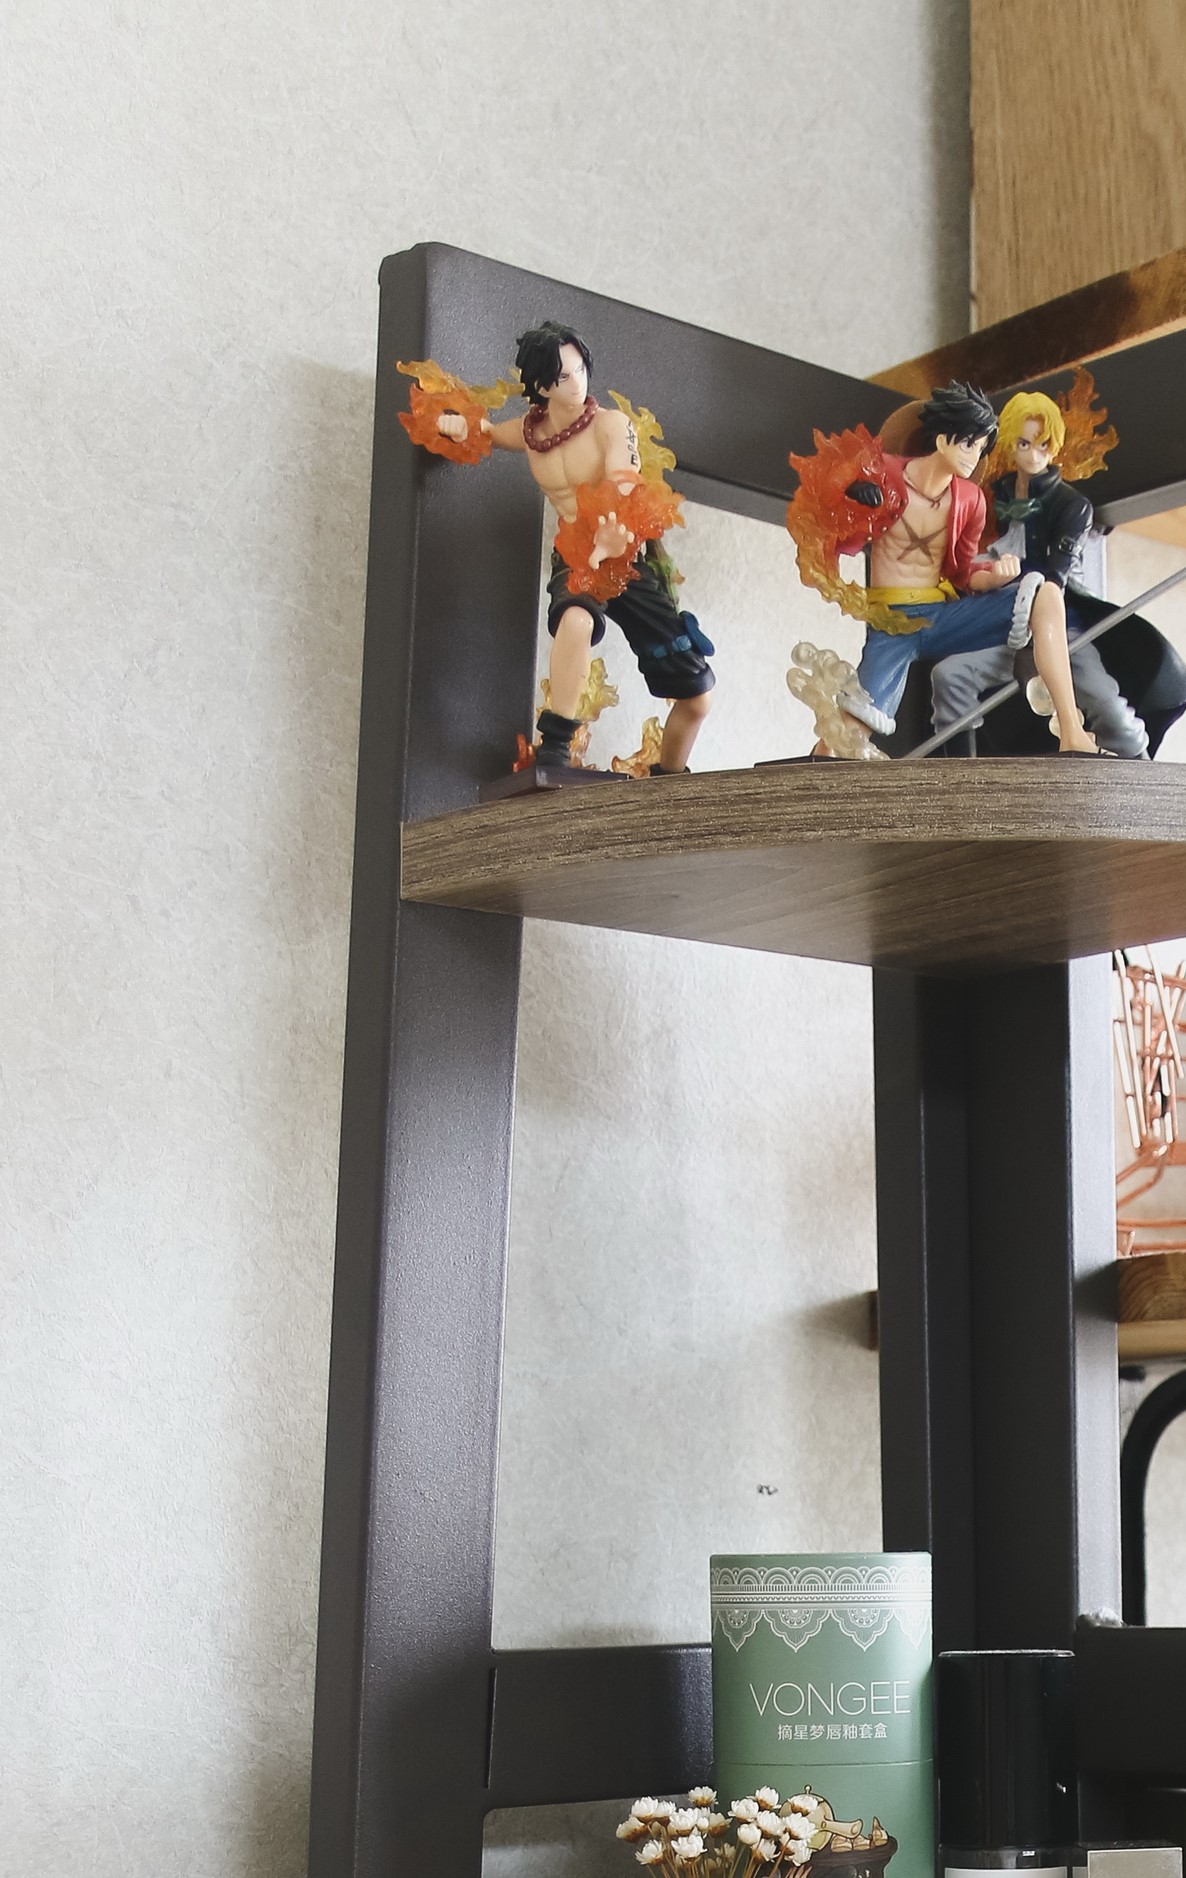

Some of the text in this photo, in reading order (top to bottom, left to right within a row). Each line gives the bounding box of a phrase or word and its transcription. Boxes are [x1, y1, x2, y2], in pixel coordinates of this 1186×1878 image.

[749, 1680, 911, 1717] VONGEE
[777, 1722, 888, 1741] 摘星梦唇釉套盒
